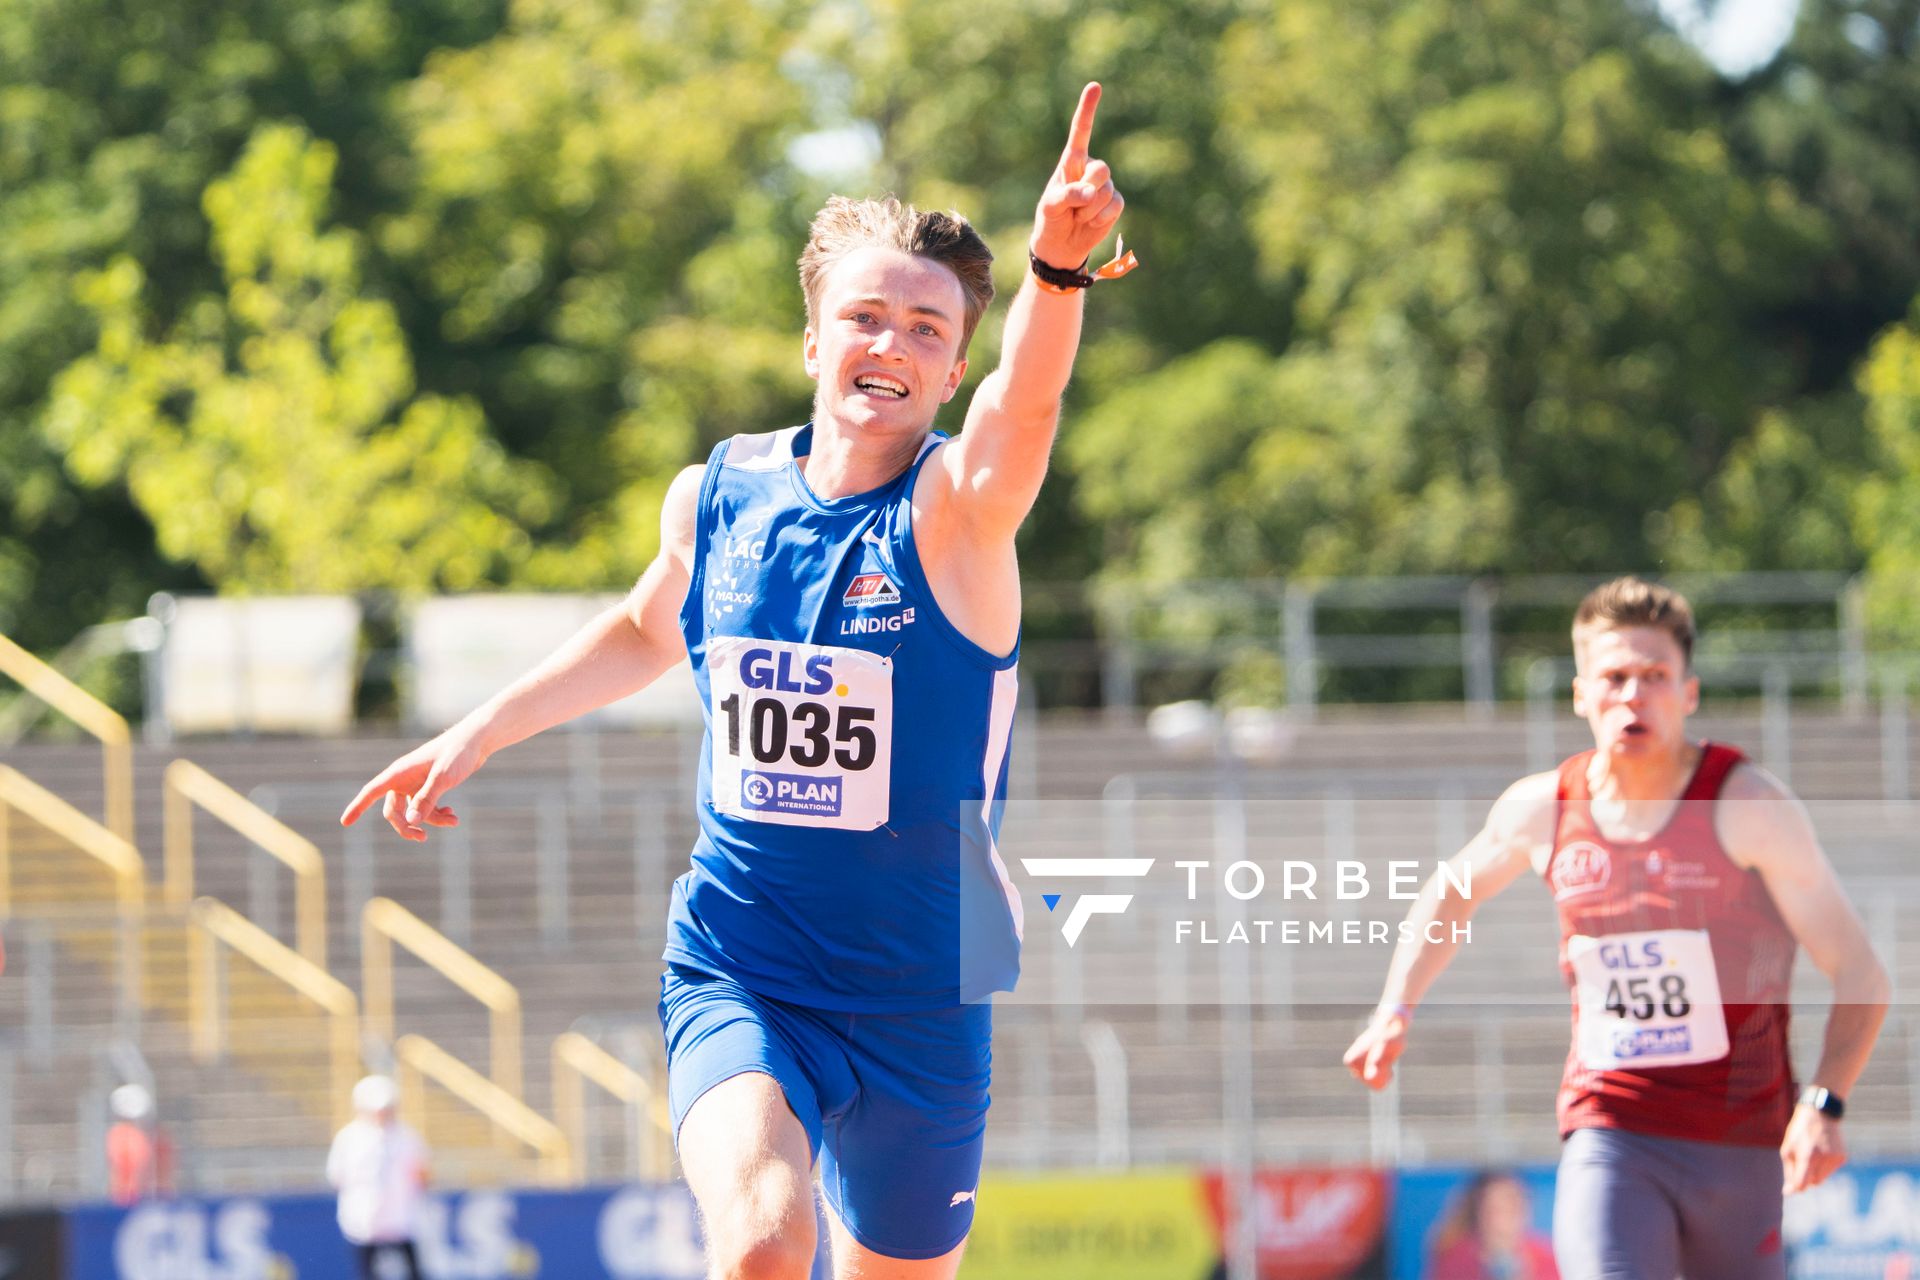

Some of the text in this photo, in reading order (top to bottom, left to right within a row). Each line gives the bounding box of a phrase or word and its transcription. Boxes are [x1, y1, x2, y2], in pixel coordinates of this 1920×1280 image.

[724, 537, 767, 561] LAC
[853, 580, 878, 593] HTI
[715, 591, 754, 604] MAXX
[843, 595, 900, 606] www.hti-gotha.de
[840, 615, 901, 635] LINDIG
[720, 693, 877, 771] 1035
[777, 781, 838, 803] PLAN
[777, 801, 837, 812] INTERNATIONAL
[1605, 975, 1691, 1020] 458
